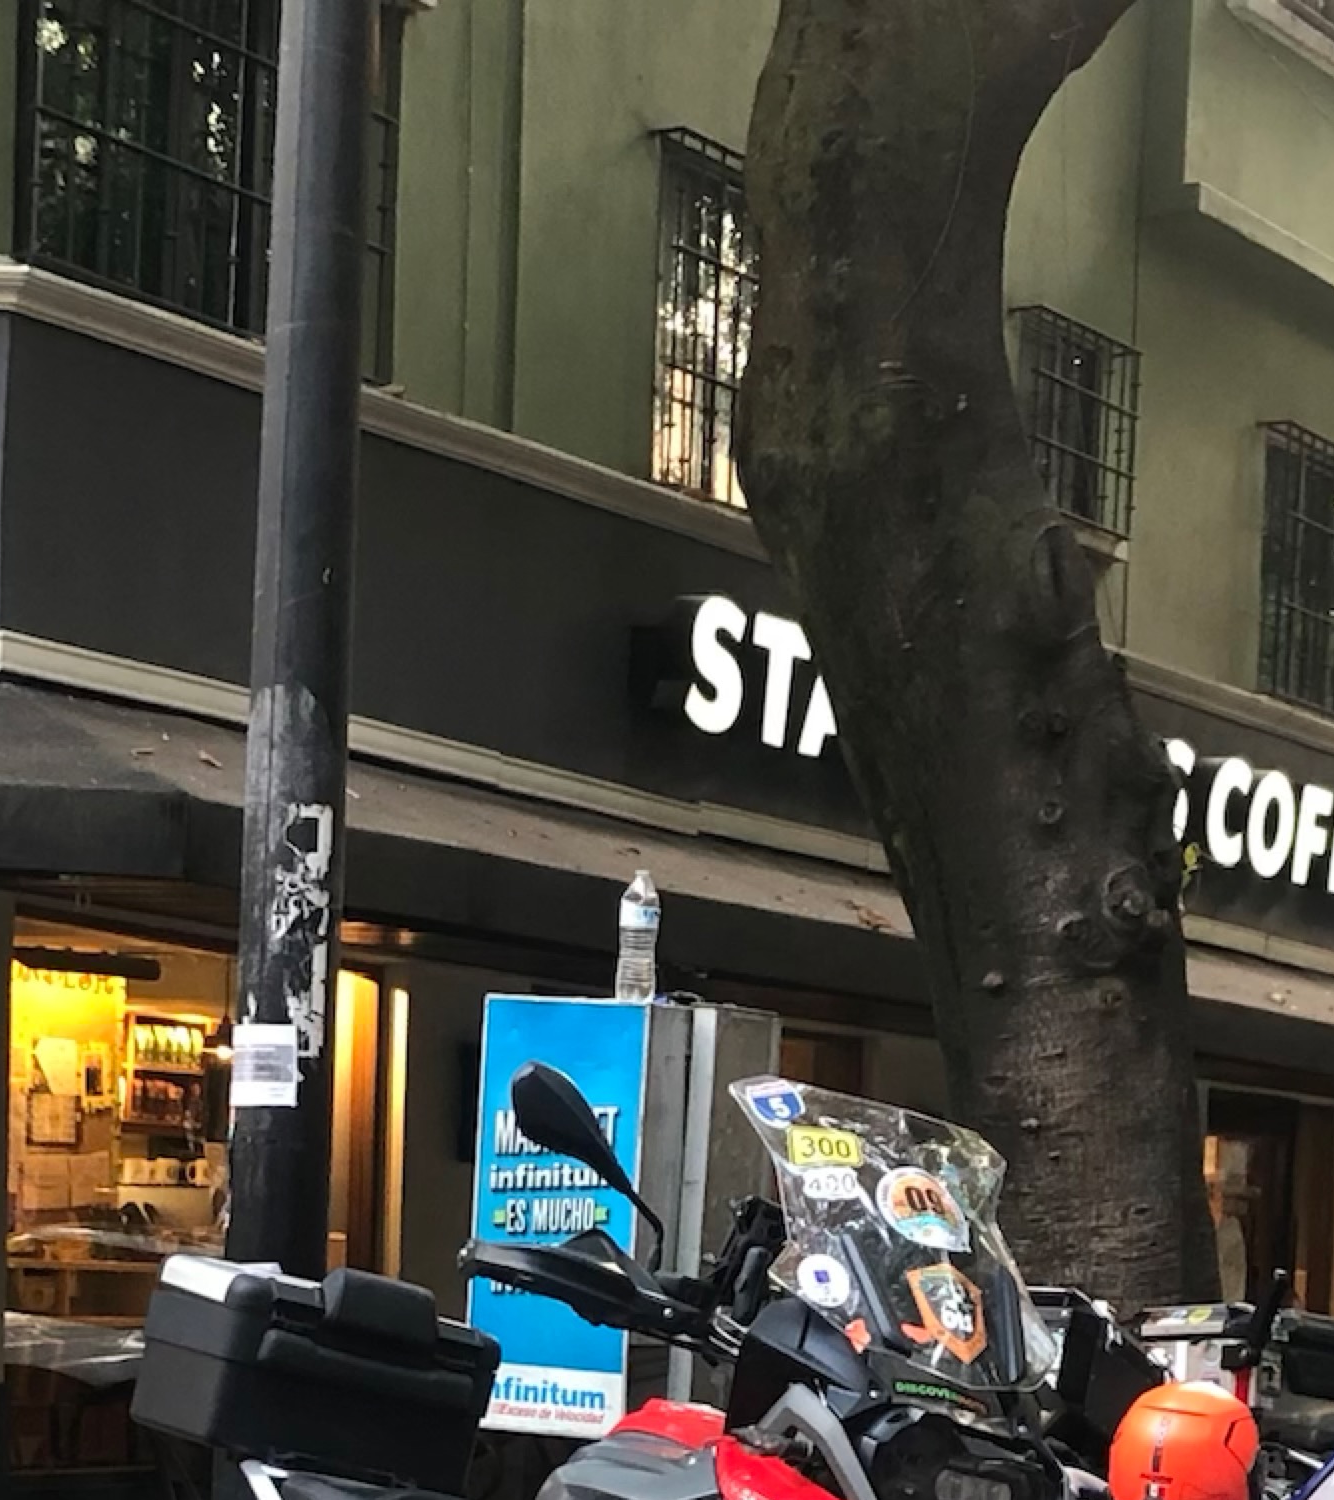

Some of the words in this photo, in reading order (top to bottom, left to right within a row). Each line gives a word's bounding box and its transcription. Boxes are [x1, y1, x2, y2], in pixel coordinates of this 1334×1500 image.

[768, 1097, 792, 1120] 5
[799, 1135, 852, 1160] 300
[506, 1199, 527, 1233] ES
[532, 1197, 595, 1233] MUCHO
[493, 1377, 606, 1410] nfinitum
